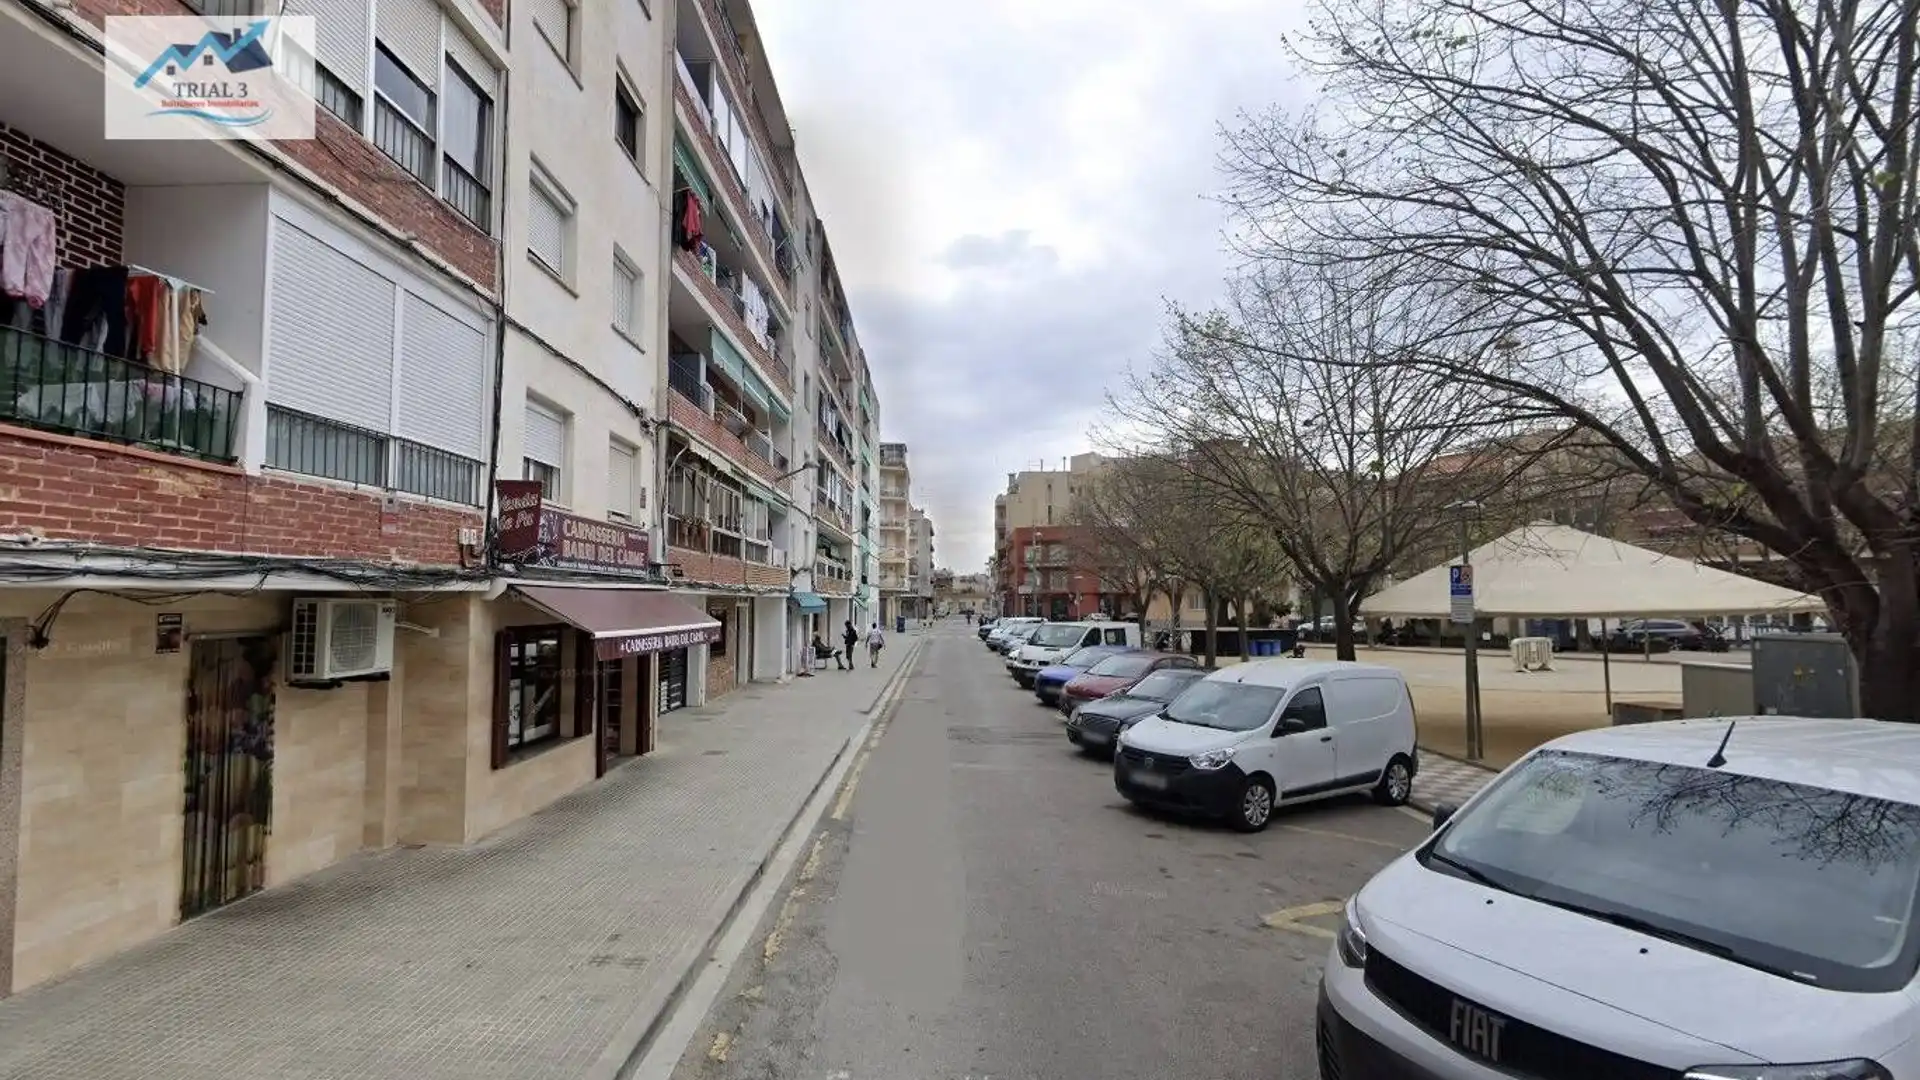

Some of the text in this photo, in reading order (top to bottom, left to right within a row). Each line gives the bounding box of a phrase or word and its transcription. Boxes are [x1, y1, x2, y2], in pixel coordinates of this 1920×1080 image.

[563, 519, 627, 547] CARNISSERIA
[562, 540, 645, 567] BARRI DEL CARME
[1452, 568, 1459, 582] P
[625, 636, 663, 653] CARNISSERIA
[1450, 998, 1505, 1062] FIAT
